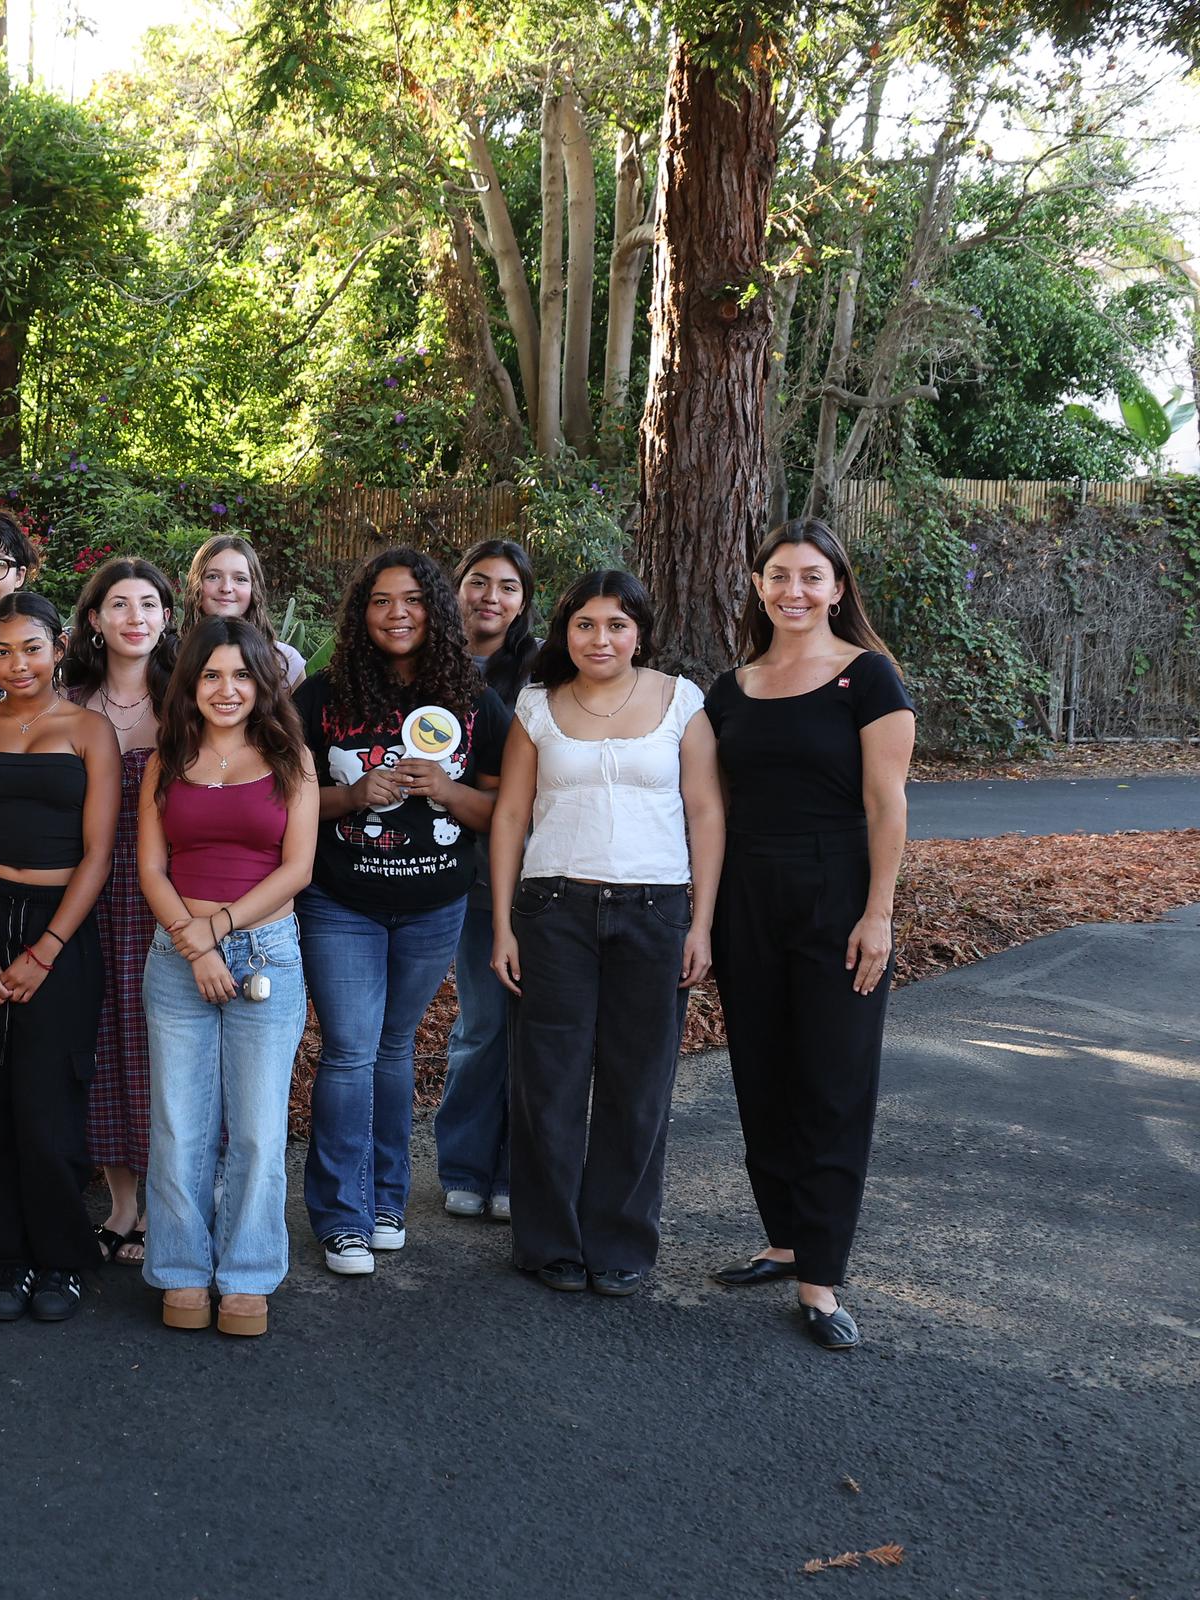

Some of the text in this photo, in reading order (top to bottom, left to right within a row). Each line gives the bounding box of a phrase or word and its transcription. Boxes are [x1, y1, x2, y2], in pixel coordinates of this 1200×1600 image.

[362, 856, 379, 864] YOU
[419, 856, 437, 864] WAY
[353, 858, 457, 877] BRIGHTENING MY DAY
